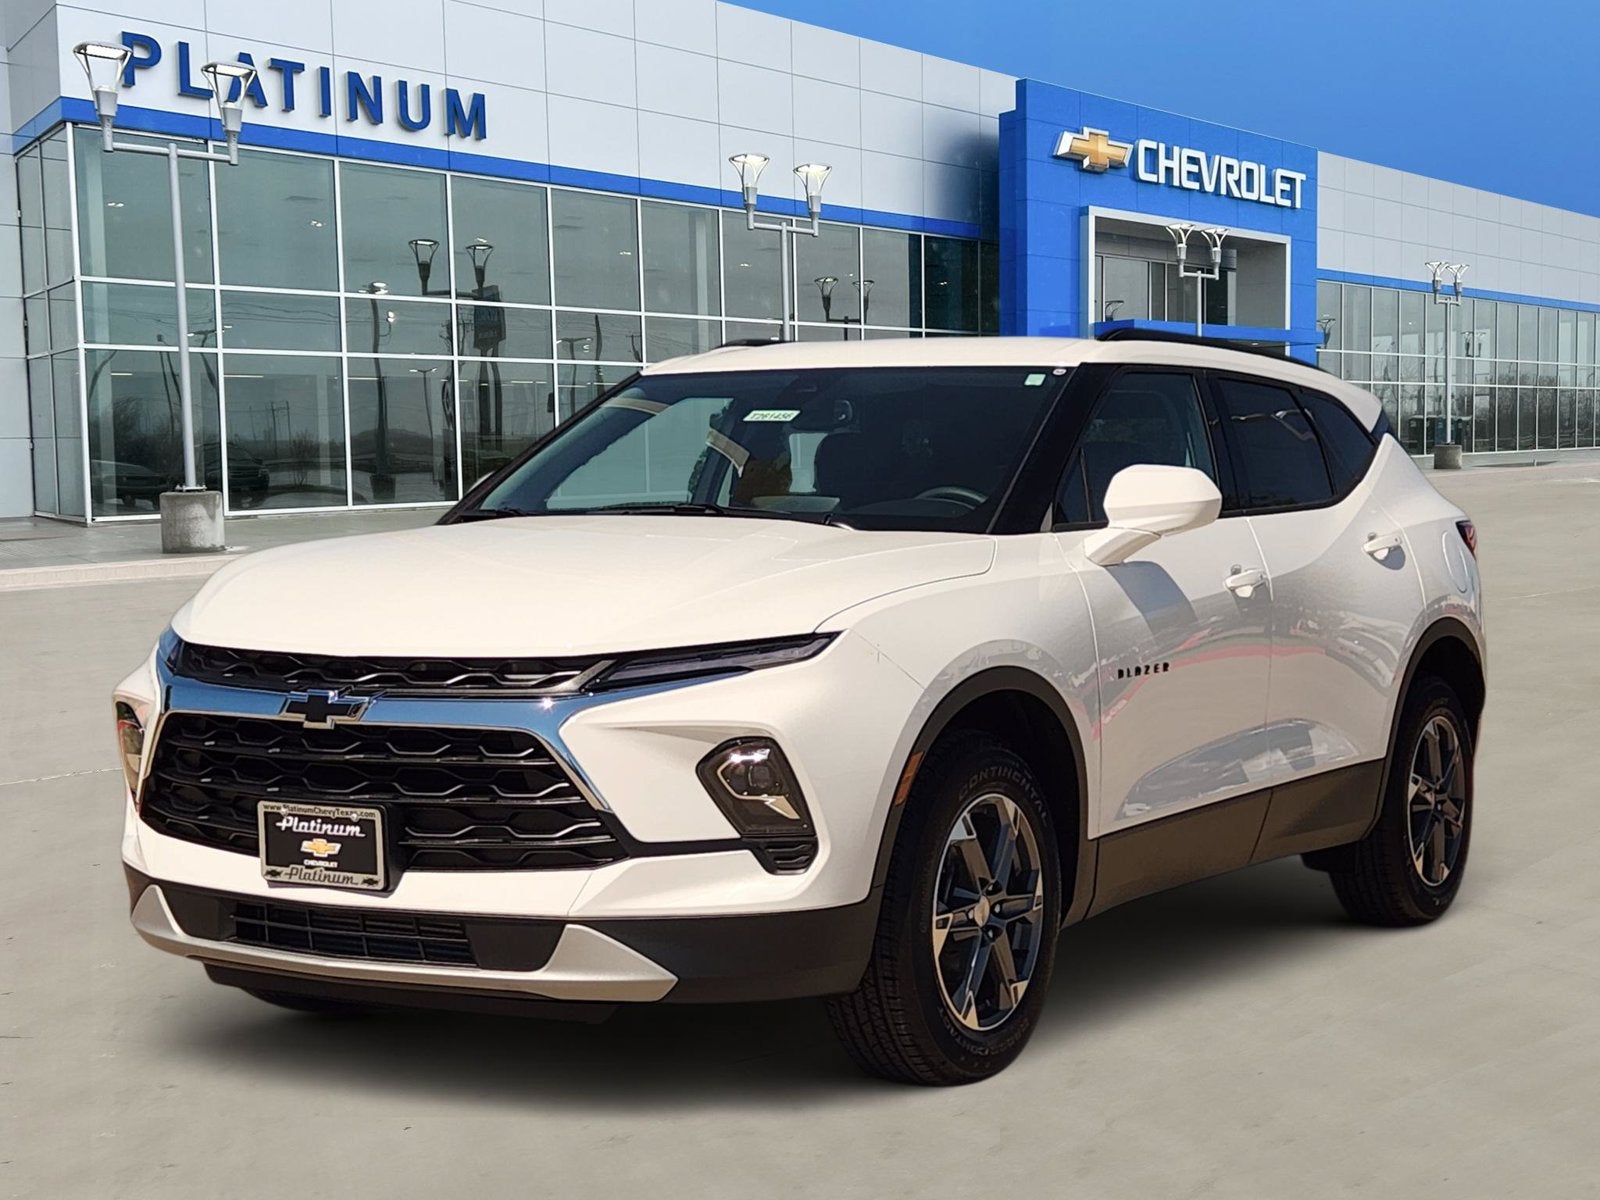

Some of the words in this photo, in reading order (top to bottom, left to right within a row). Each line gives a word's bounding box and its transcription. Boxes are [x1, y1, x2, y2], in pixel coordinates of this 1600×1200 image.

[120, 31, 486, 141] PLATINUM
[1138, 139, 1306, 208] CHEVROLET
[1118, 662, 1169, 679] BLAZER
[276, 816, 366, 837] Platinum
[303, 859, 338, 868] CHEVROLET
[284, 866, 359, 885] Platinum
